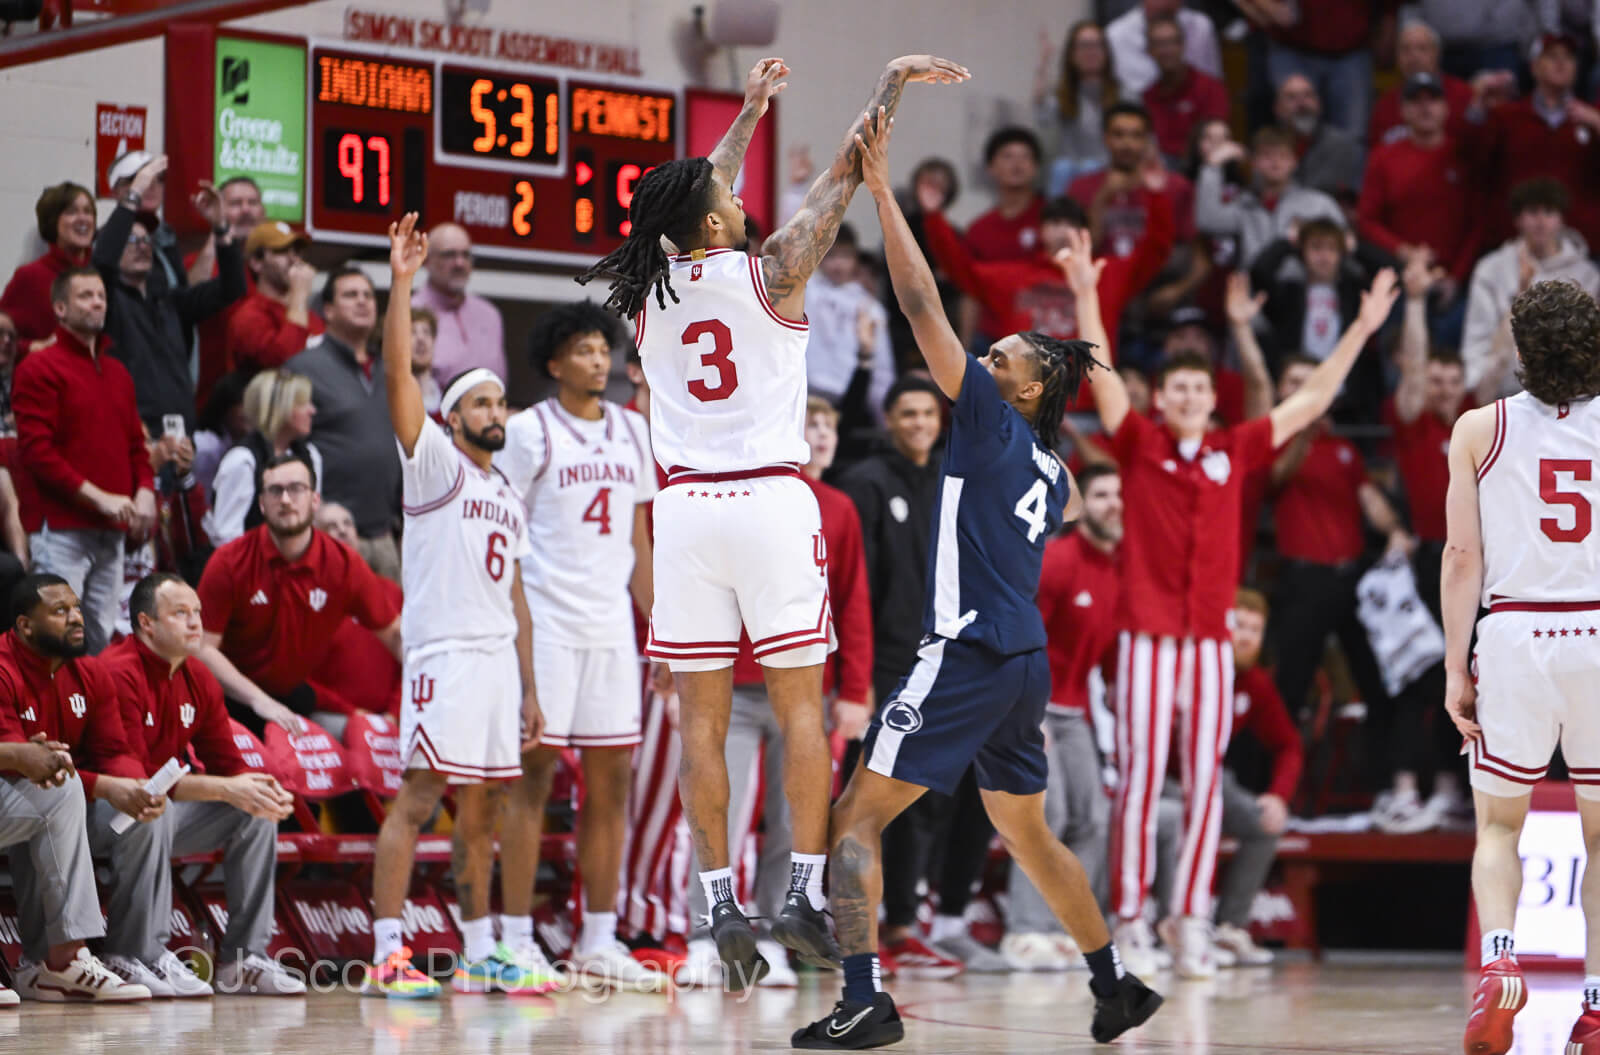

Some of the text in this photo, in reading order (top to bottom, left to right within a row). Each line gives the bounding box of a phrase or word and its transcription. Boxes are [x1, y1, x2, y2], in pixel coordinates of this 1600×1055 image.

[350, 10, 416, 47] SIMON
[497, 31, 593, 71] ASSEMBLY
[595, 44, 643, 77] HALL
[319, 56, 431, 114] INDIANA
[99, 111, 143, 137] SECTION
[219, 108, 283, 144] Greene
[470, 79, 559, 157] 5:31
[572, 87, 673, 143] PENNST
[338, 133, 391, 206] 97
[454, 191, 509, 228] PERIOD
[512, 181, 534, 236] 2
[617, 164, 657, 237] 5
[681, 318, 739, 402] 3
[558, 464, 636, 488] INDIANA
[1539, 458, 1592, 543] 5
[462, 500, 520, 541] INDIAN
[582, 487, 612, 535] 4
[1014, 478, 1048, 544] 4
[485, 531, 508, 583] 6
